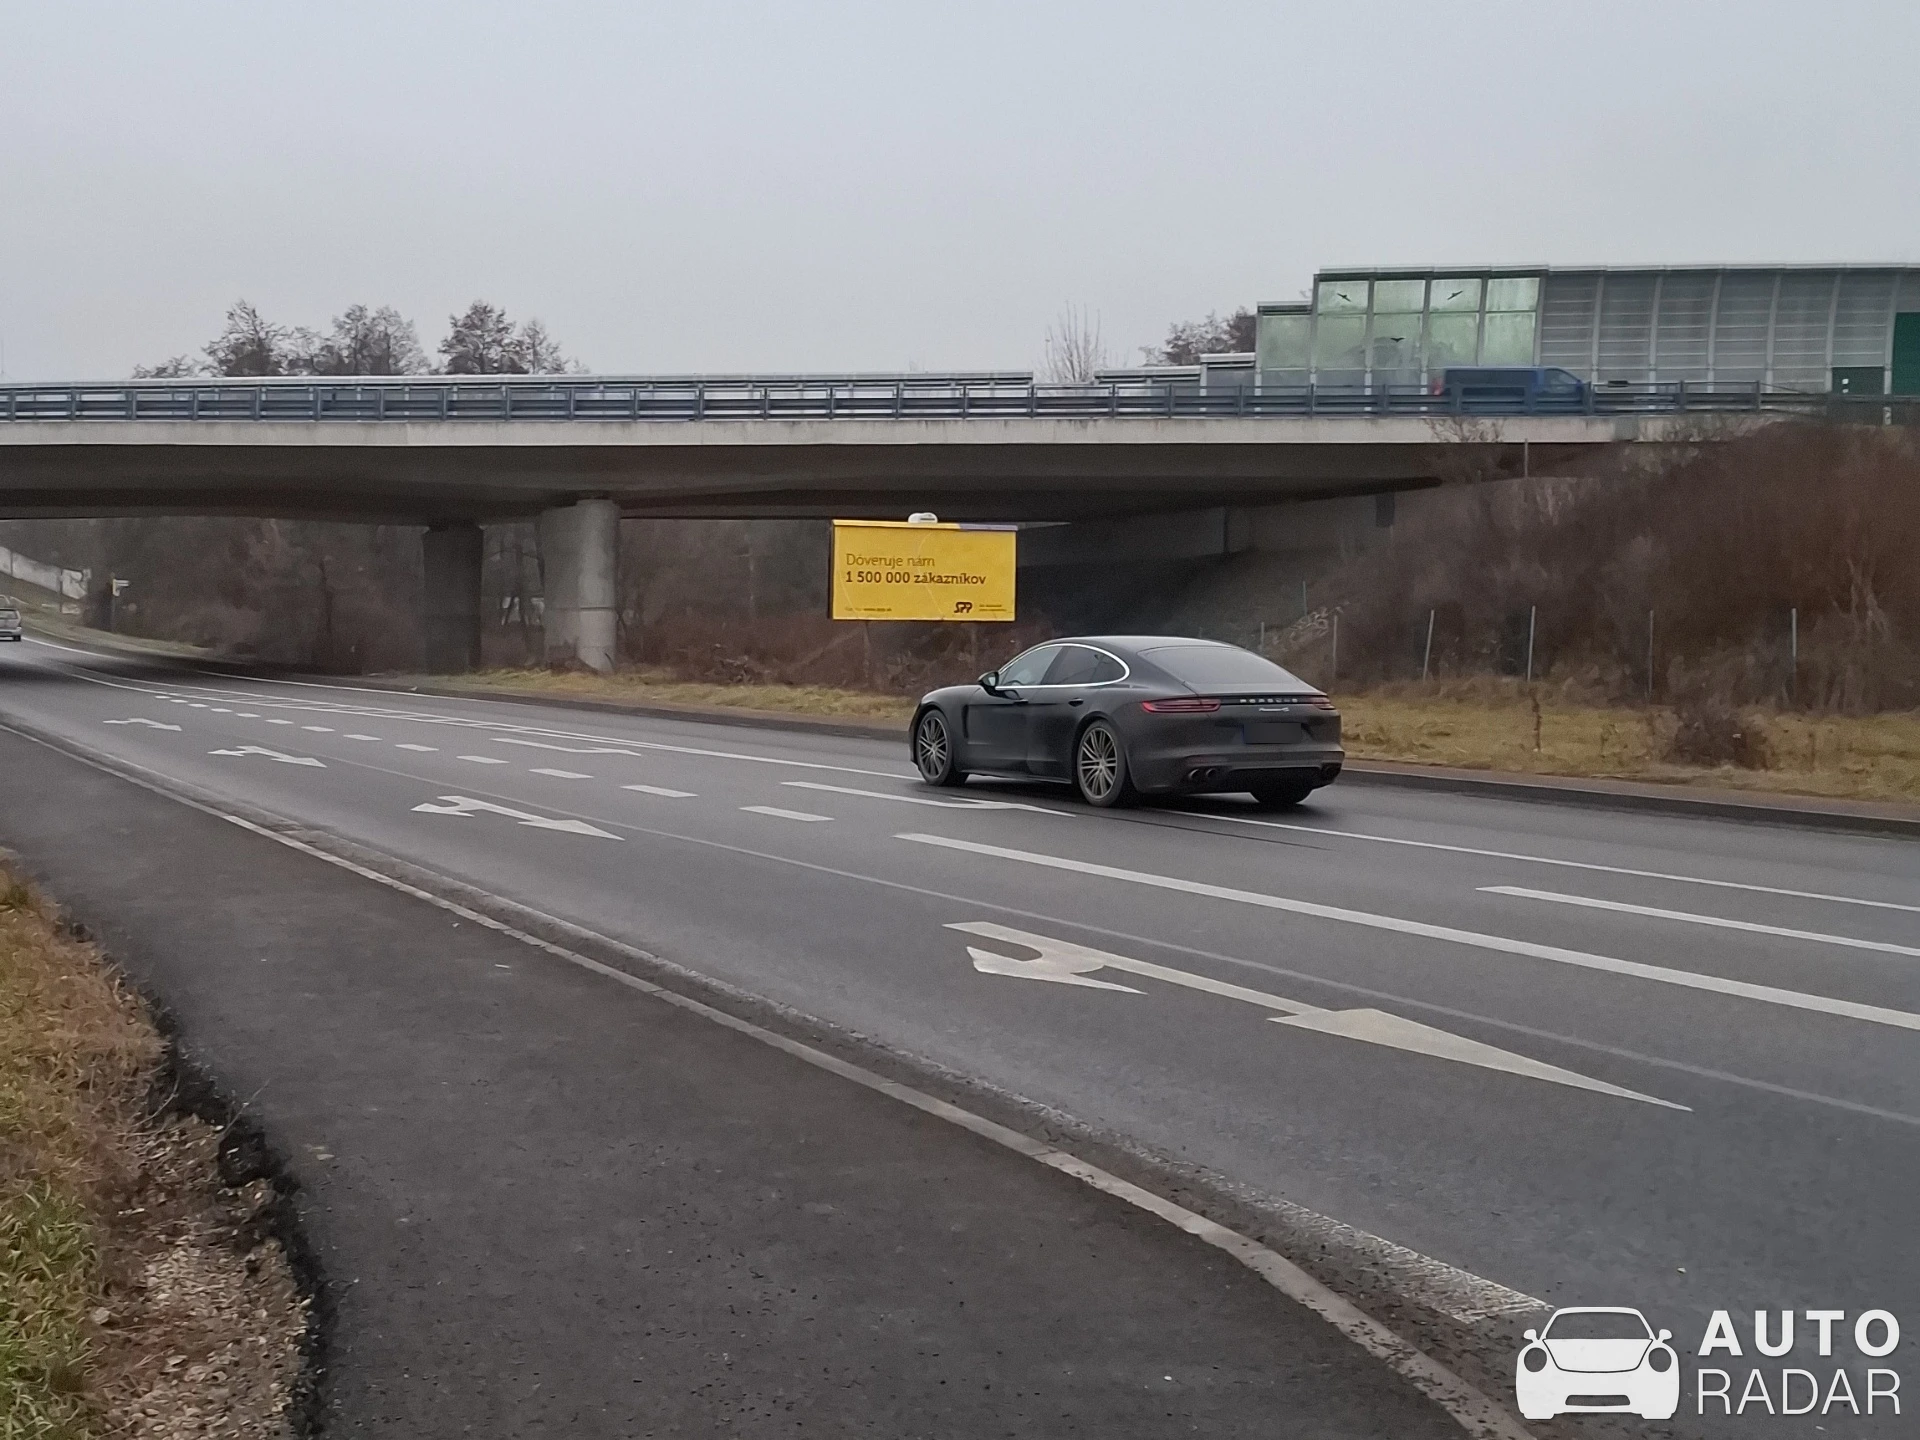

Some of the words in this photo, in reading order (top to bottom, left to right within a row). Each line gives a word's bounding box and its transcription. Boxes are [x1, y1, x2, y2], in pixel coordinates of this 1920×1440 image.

[907, 555, 935, 566] nám
[846, 571, 853, 583] 1
[857, 571, 882, 583] 500
[886, 571, 910, 583] 000
[914, 572, 986, 584] zákazníkov
[954, 602, 973, 613] SPP
